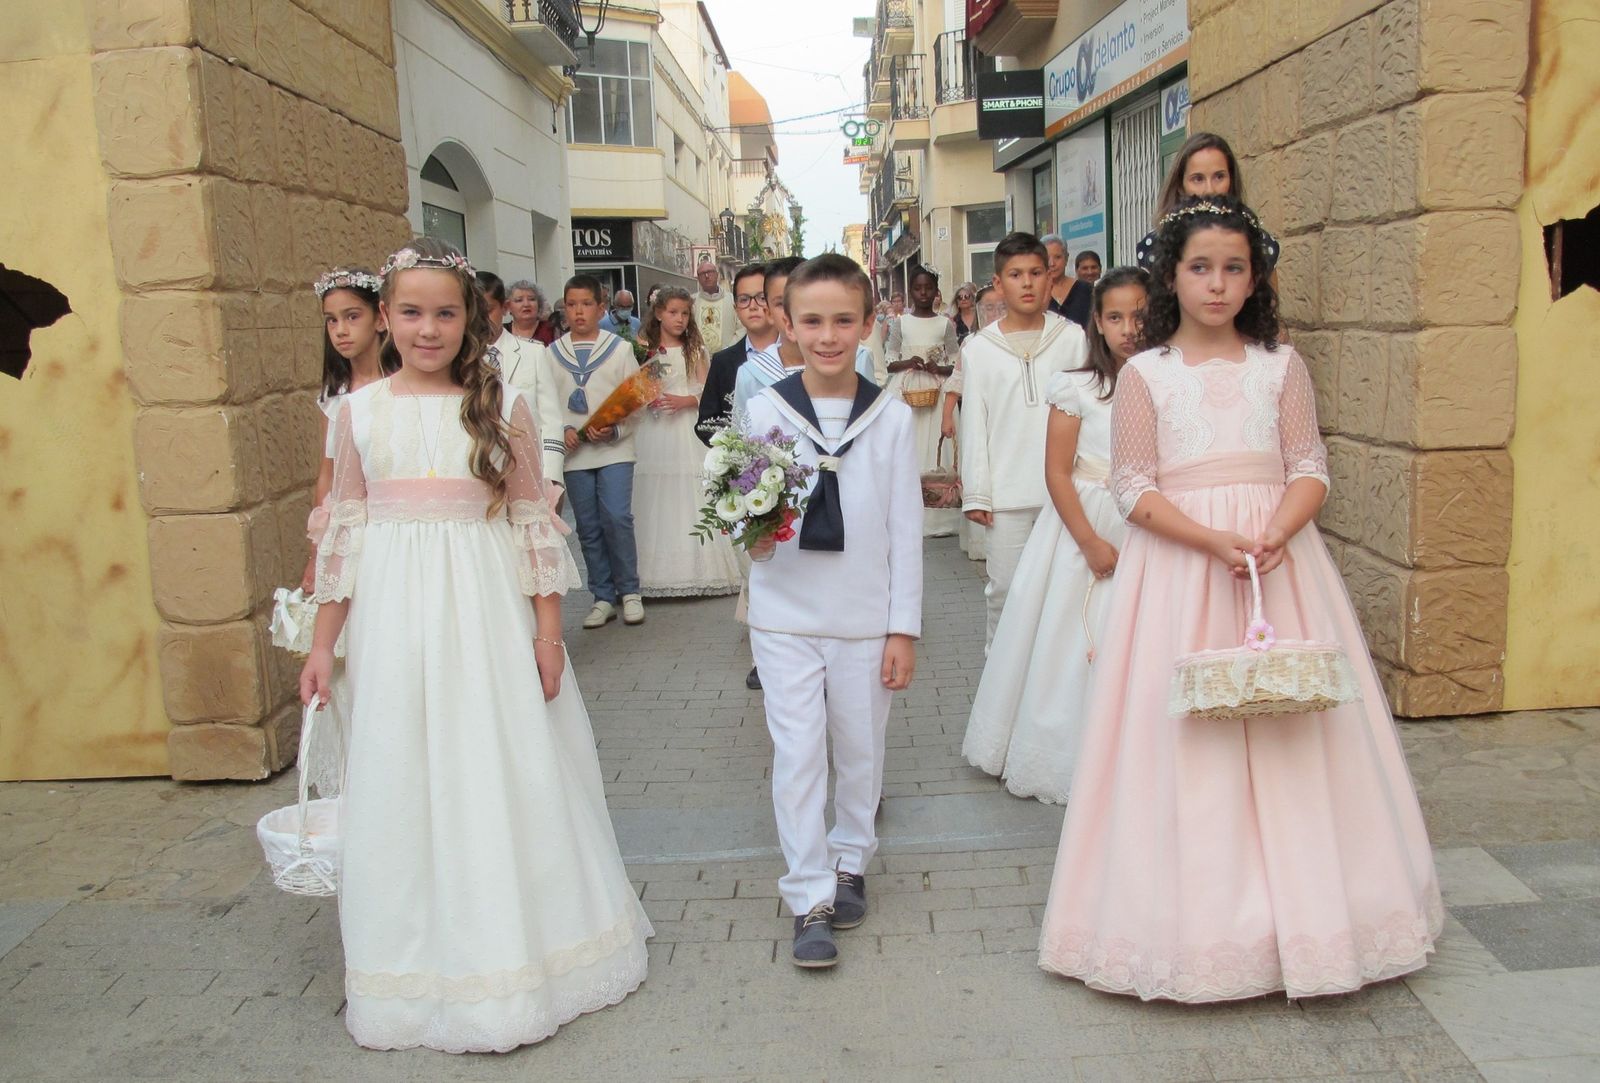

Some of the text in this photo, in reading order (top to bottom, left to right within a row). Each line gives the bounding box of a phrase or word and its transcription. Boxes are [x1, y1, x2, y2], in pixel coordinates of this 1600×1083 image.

[1143, 3, 1158, 24] Project
[1143, 48, 1157, 64] Obras
[1162, 31, 1184, 52] Servicios
[1049, 66, 1076, 101] Grupo
[983, 98, 1043, 109] SMART&PHONE
[577, 248, 613, 256] ZAPATERÍAS
